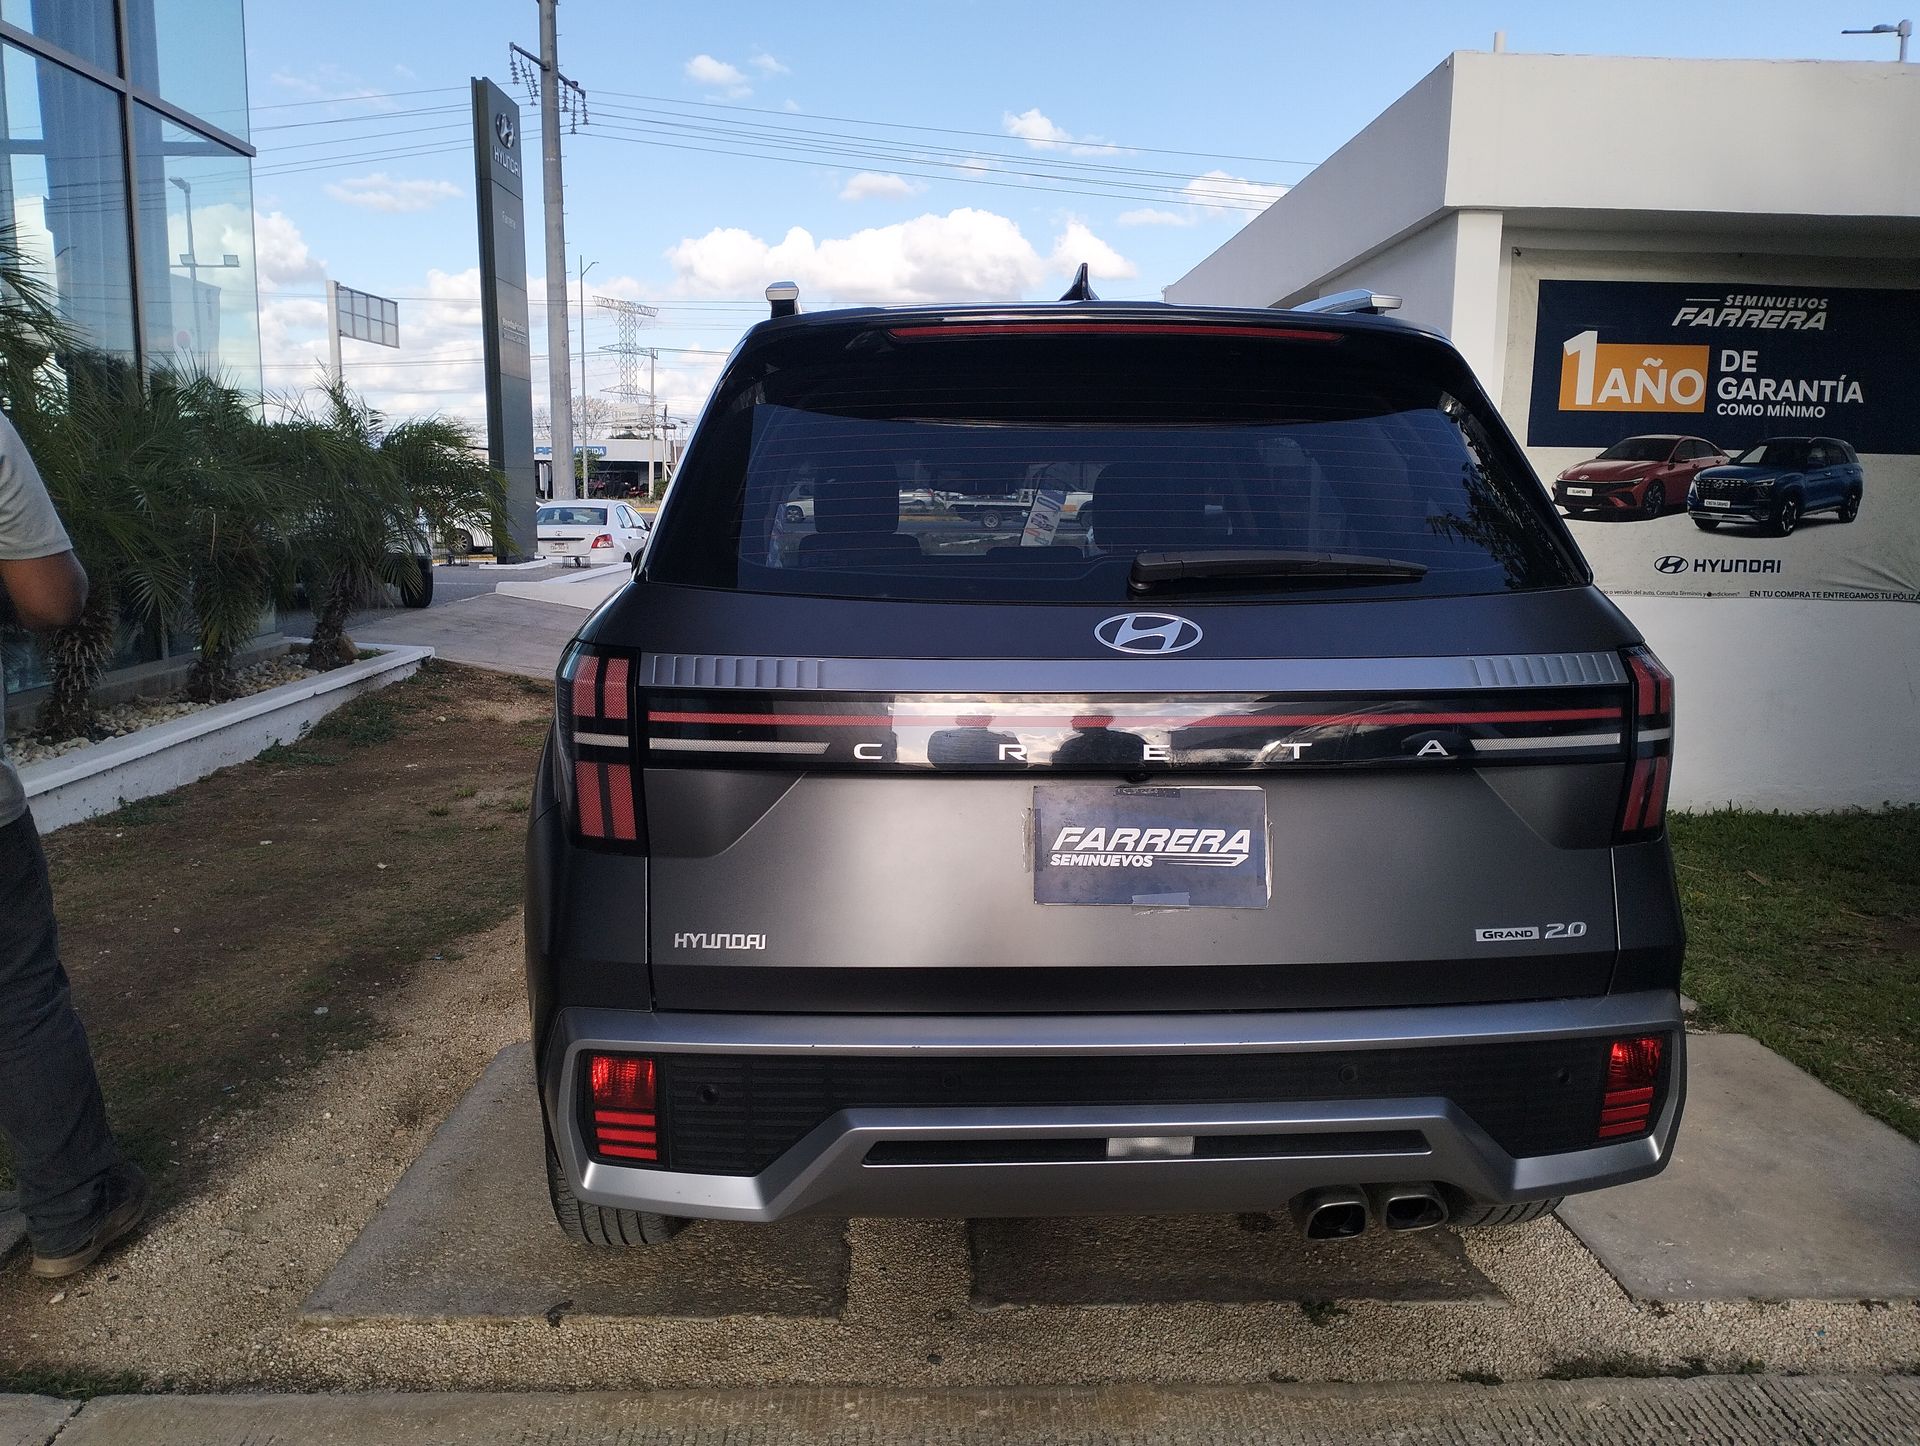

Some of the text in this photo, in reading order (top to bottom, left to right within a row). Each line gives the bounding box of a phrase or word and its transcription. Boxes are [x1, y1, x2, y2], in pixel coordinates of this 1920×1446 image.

[493, 145, 520, 178] HYUNDAI
[1724, 294, 1829, 309] SEMINUEVOS
[1671, 307, 1827, 331] FARRERA
[1563, 330, 1705, 406] 1 AÑO
[1720, 349, 1758, 373] DE
[1717, 375, 1864, 404] GARANTÍA
[1716, 402, 1826, 418] COMO MÍNIMO
[1693, 559, 1781, 573] HYUNDAI
[1051, 826, 1250, 853] FARRERA
[1050, 854, 1153, 868] SEMINUEVOS
[674, 932, 766, 950] HYUNDAI
[1482, 930, 1533, 939] GRAND
